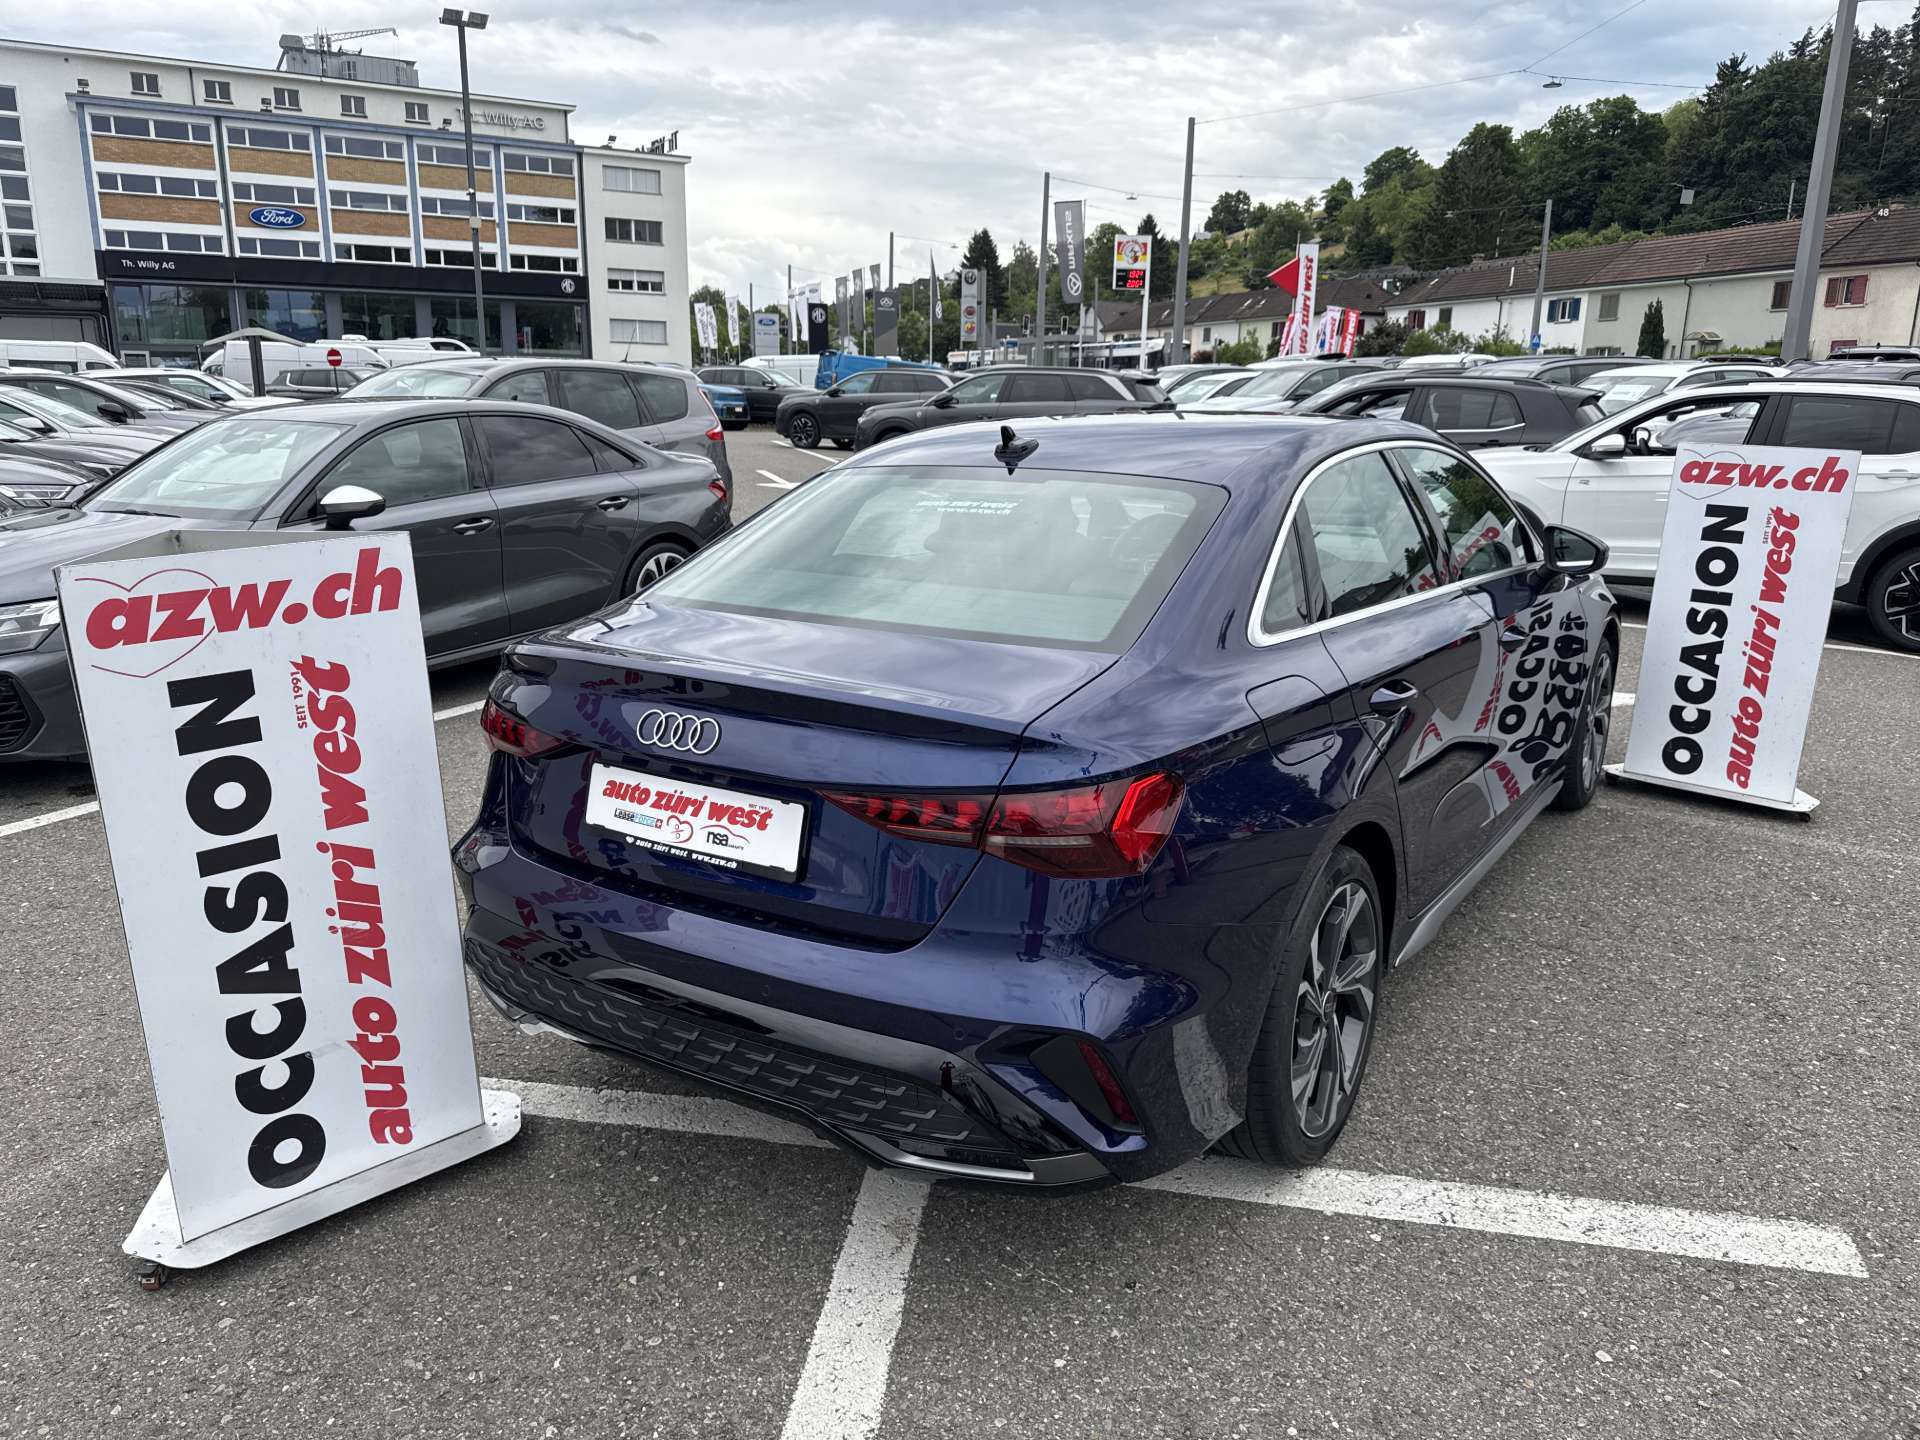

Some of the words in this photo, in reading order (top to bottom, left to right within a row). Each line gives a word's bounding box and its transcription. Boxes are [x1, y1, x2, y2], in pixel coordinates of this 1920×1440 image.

[484, 111, 519, 129] Willy
[523, 115, 545, 130] AG
[260, 209, 294, 225] Ford
[1877, 208, 1889, 217] 48
[121, 259, 135, 268] Th.
[137, 260, 160, 270] Willy
[162, 261, 175, 270] AG
[1680, 457, 1848, 493] azw.ch
[1760, 506, 1800, 604] west
[86, 548, 402, 649] azw.ch
[1662, 504, 1749, 775] OCCASION
[1742, 606, 1781, 698] züri
[290, 671, 303, 700] 1991
[295, 704, 308, 729] SEIT
[289, 656, 369, 830] west
[1726, 697, 1763, 789] auto
[602, 779, 651, 805] auto
[650, 788, 707, 818] züri
[708, 802, 773, 831] west
[635, 839, 652, 849] auto
[670, 848, 688, 858] west
[691, 852, 738, 869] www.azw.ch
[706, 831, 729, 847] nsa
[167, 669, 327, 1189] OCCASION
[317, 842, 392, 988] züri
[345, 997, 413, 1145] auto
